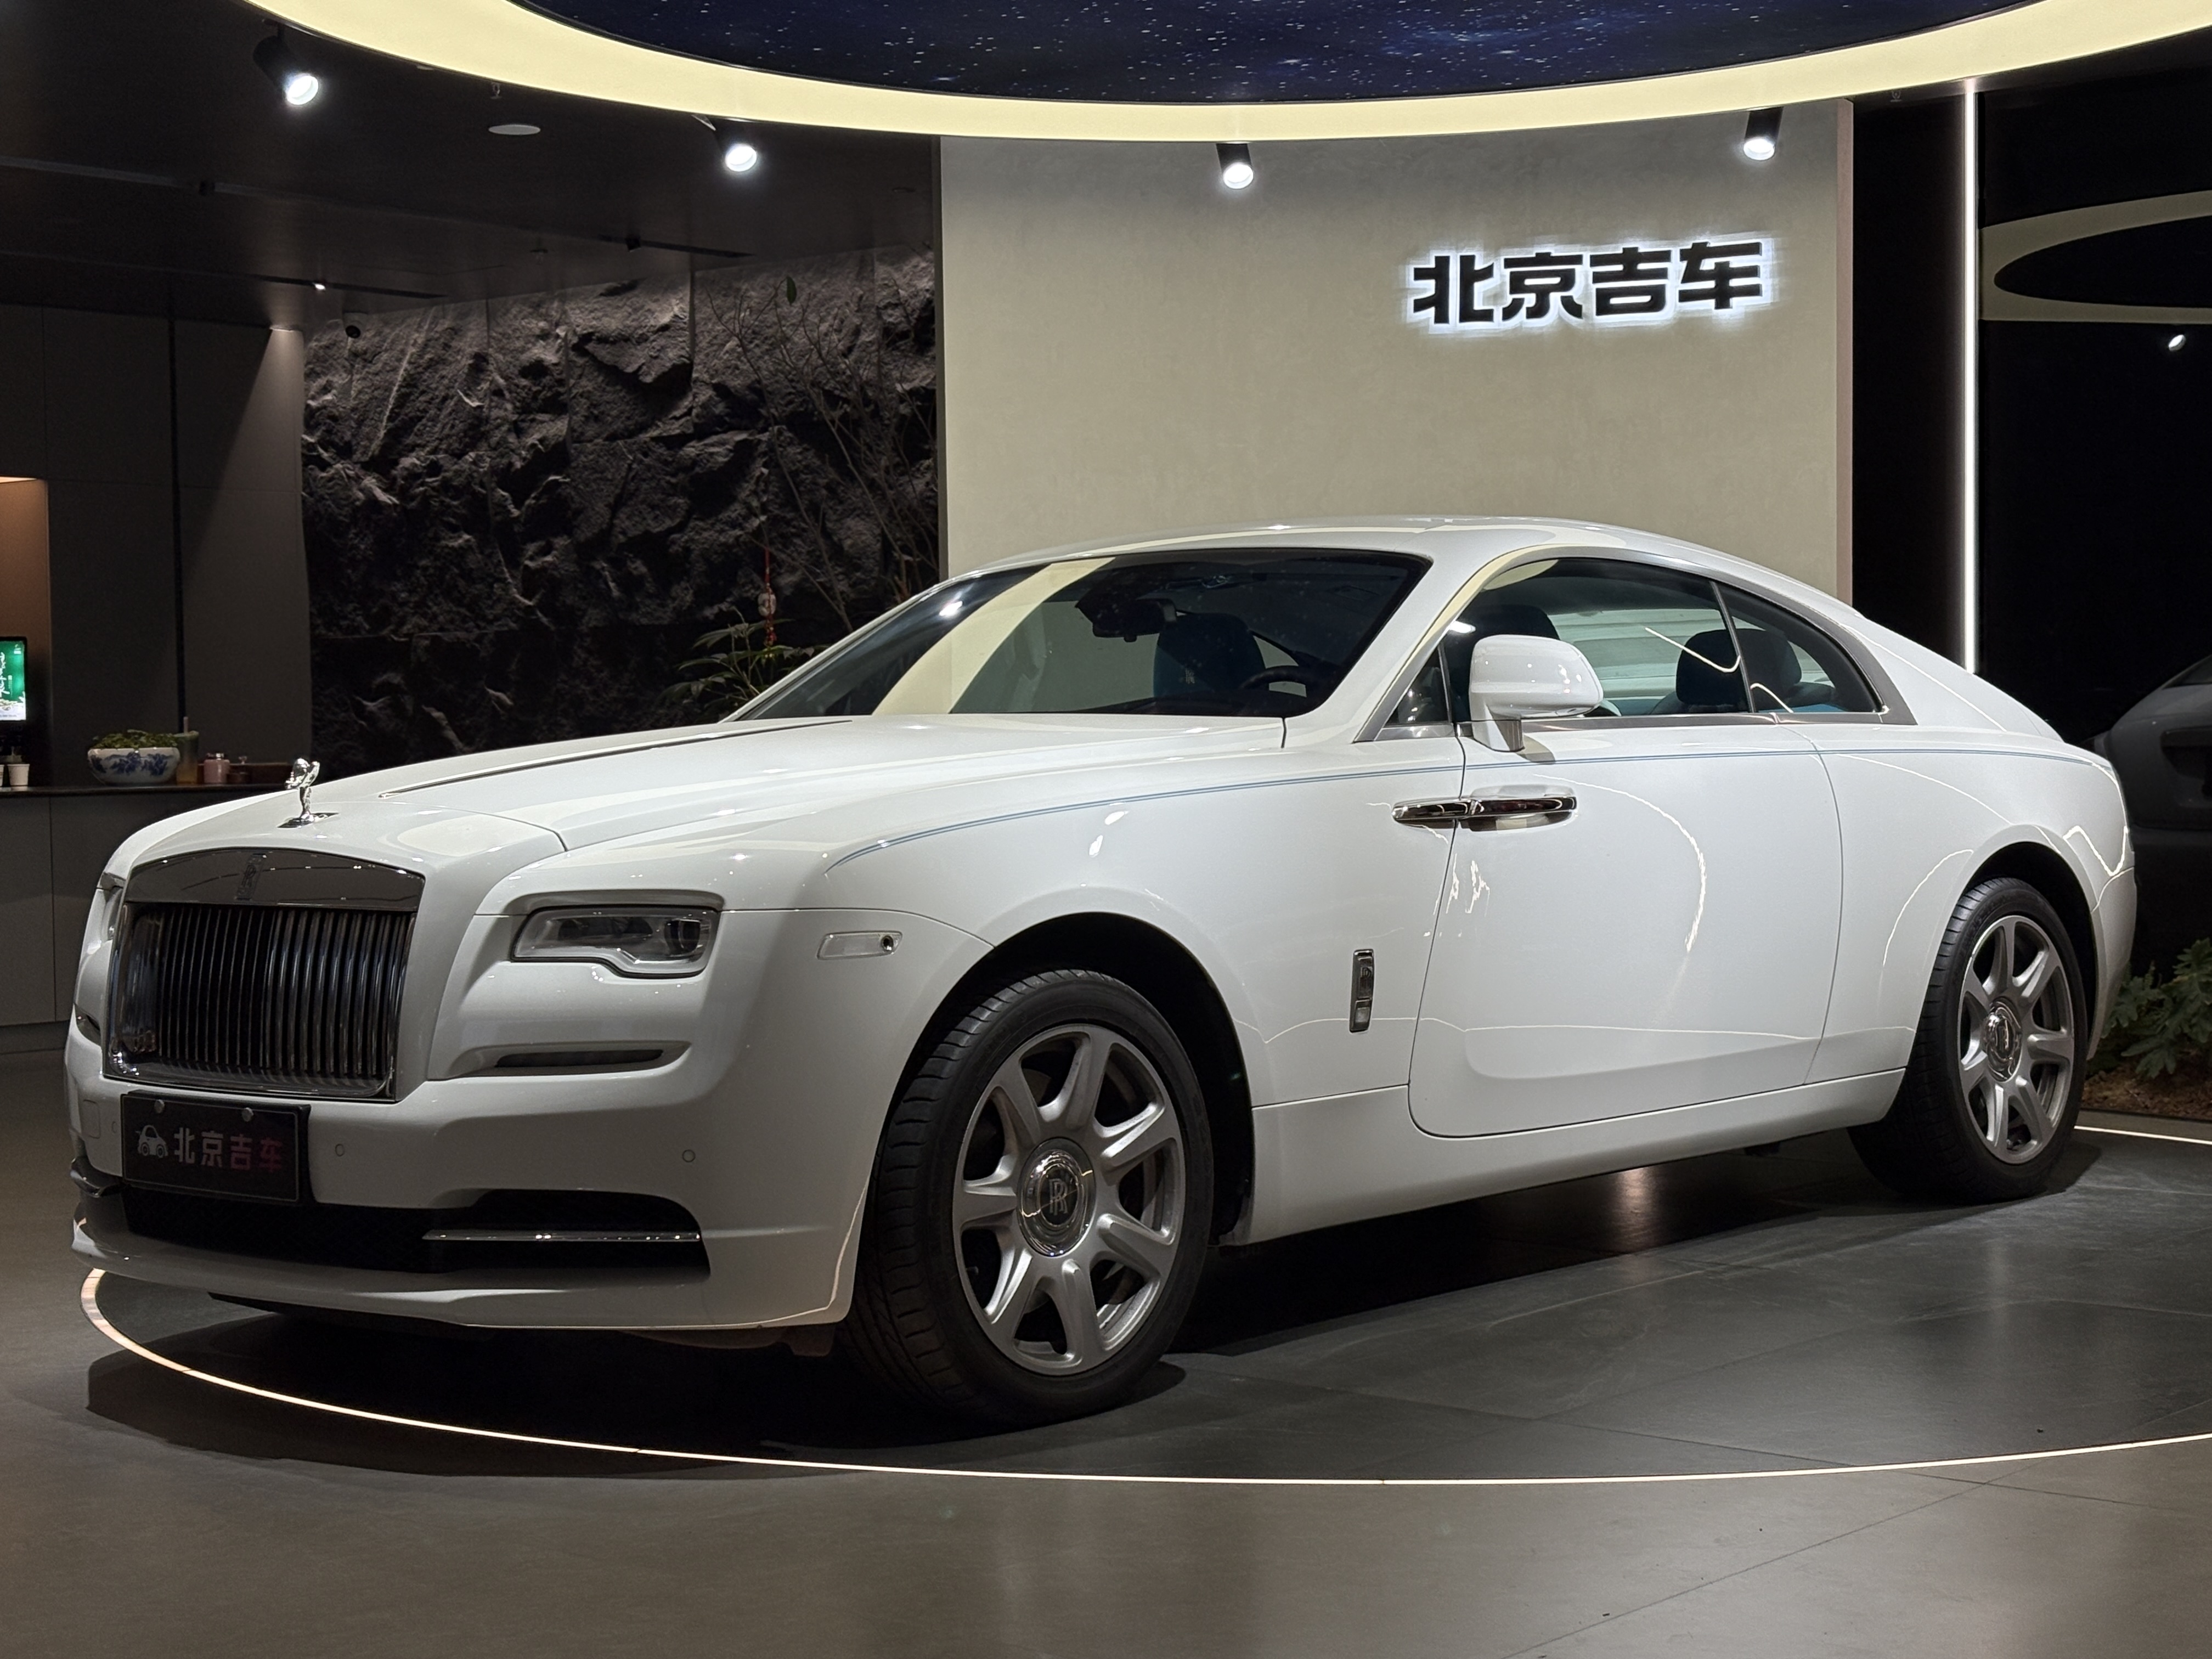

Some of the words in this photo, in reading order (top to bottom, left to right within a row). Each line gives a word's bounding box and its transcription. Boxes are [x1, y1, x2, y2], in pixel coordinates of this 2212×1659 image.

[1413, 241, 1763, 324] 北京吉车
[173, 1127, 284, 1172] 北京吉车
